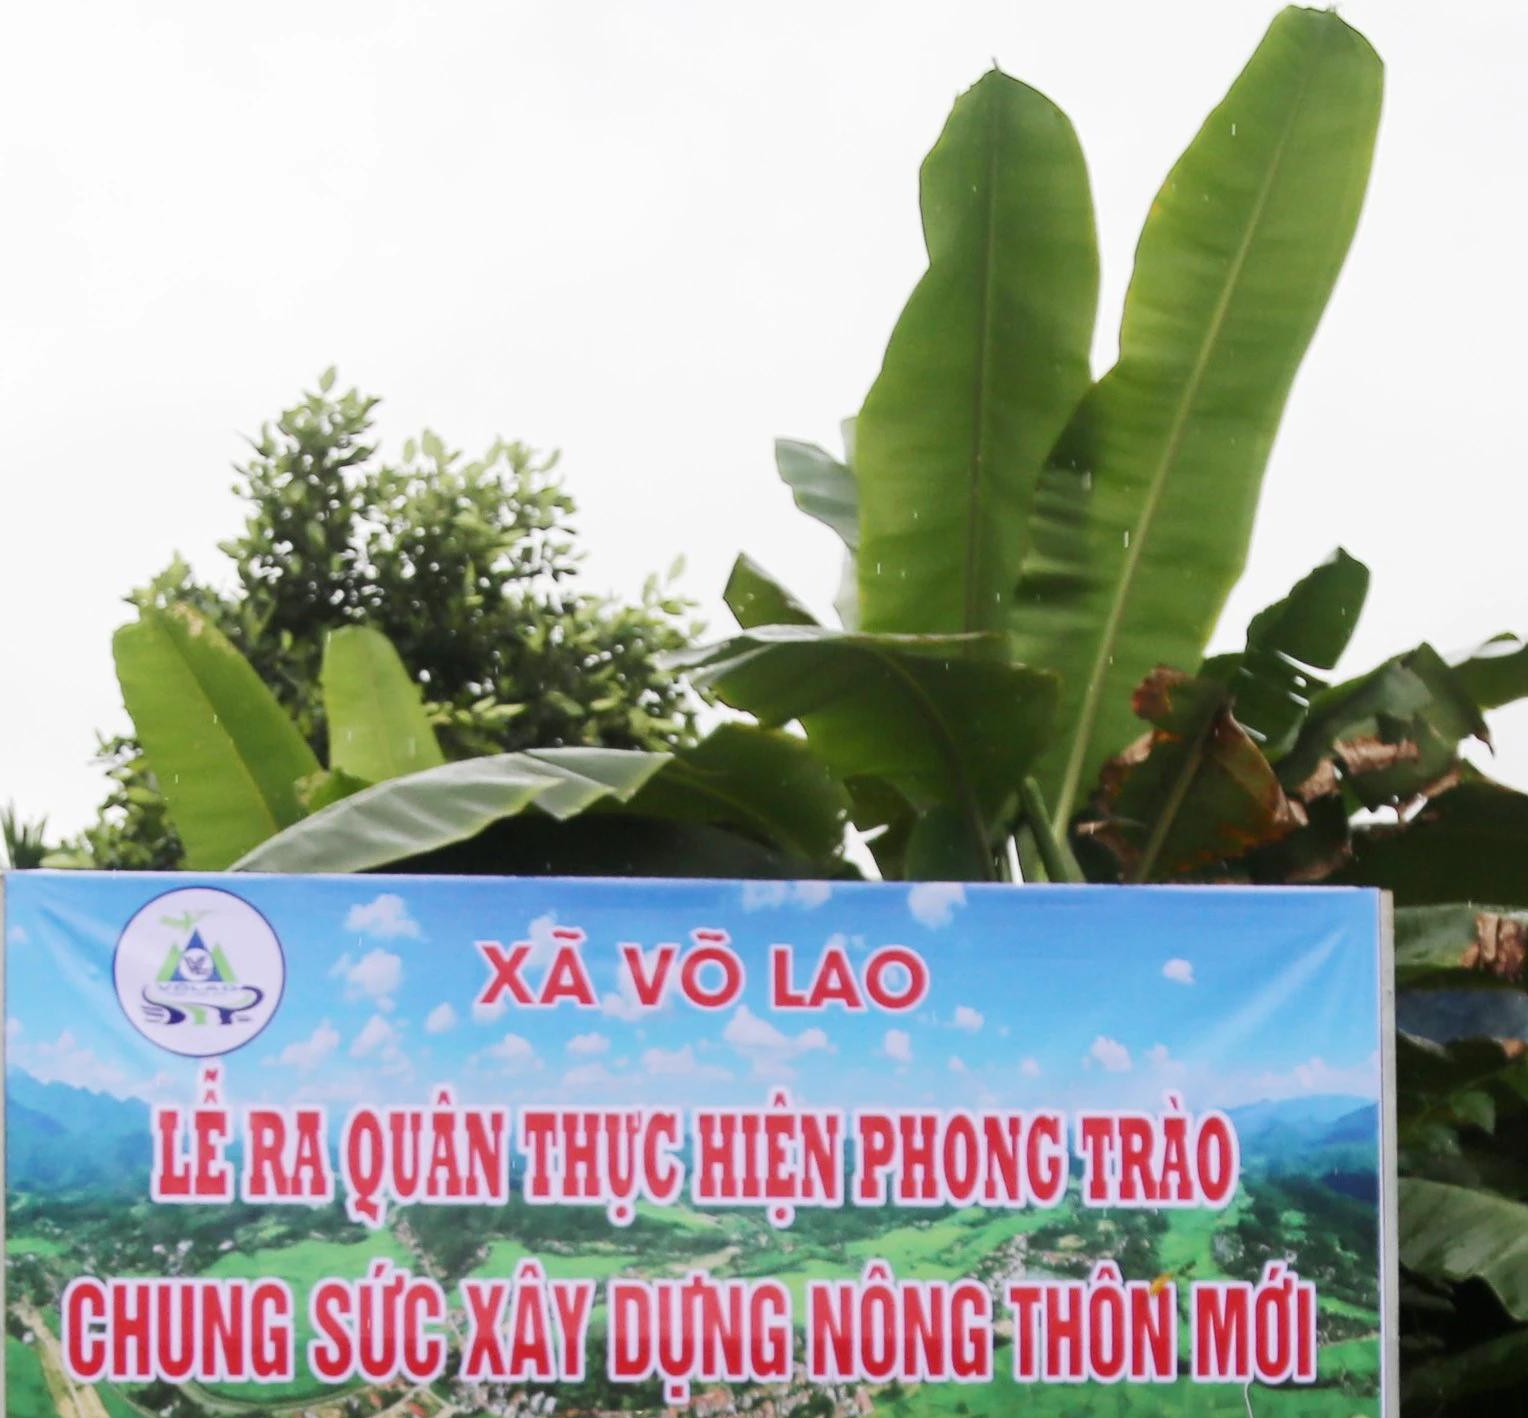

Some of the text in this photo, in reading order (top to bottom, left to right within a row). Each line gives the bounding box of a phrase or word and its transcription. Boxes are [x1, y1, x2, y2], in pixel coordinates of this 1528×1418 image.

[481, 930, 927, 1011] XÃ VÕ LAO
[158, 1069, 1234, 1222] LỄ RA QUÂN THỰC HIỆN PHONG TRÀO
[67, 1262, 1312, 1400] CHUNG SỨC XÂY DỰNG NÔNG THÔN MỚI
